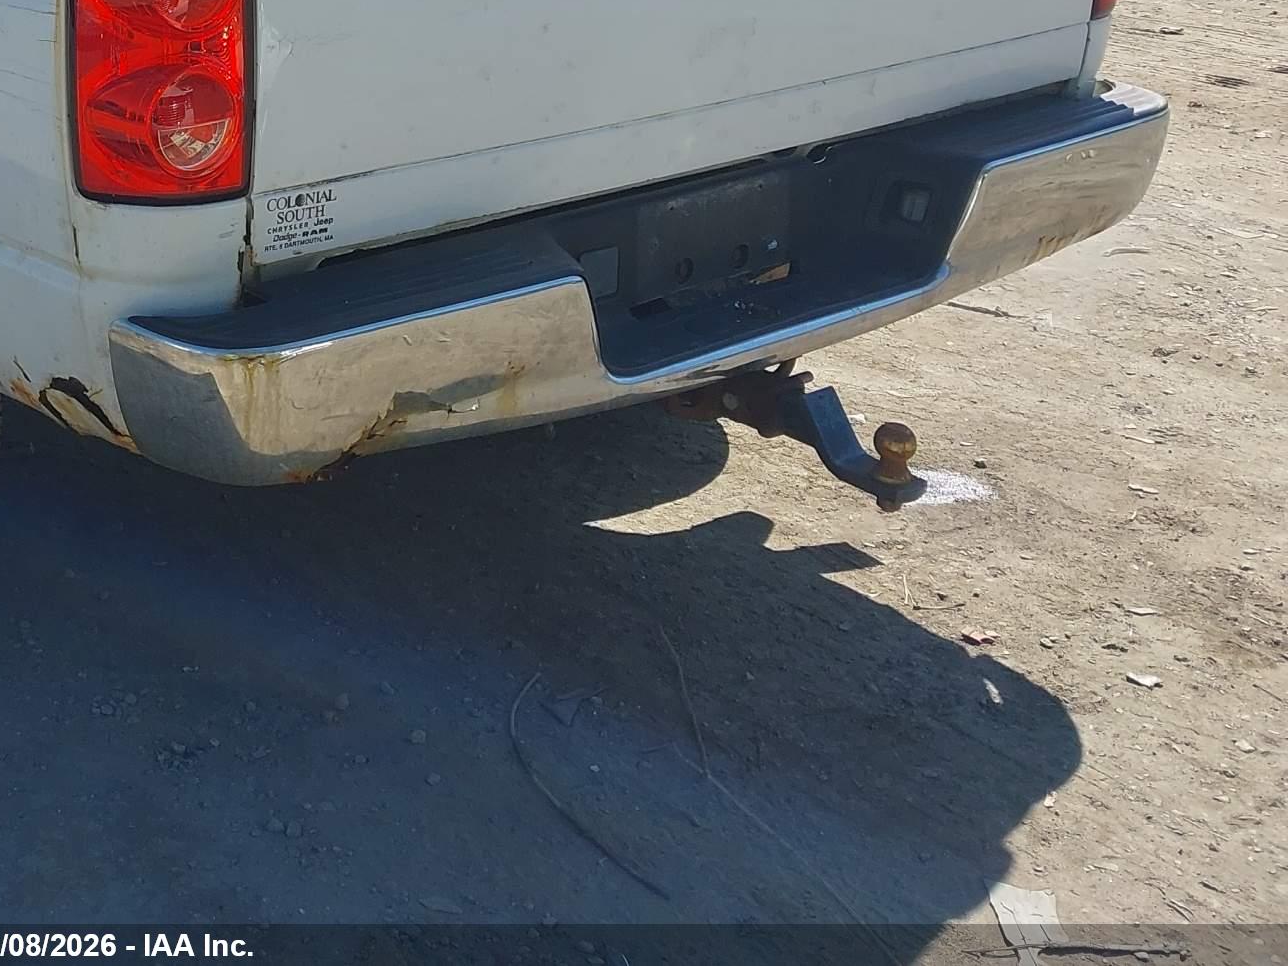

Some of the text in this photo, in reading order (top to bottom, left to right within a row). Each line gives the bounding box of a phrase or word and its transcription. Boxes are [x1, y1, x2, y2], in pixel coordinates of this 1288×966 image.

[267, 189, 337, 212] COLONIAL
[277, 205, 325, 224] SOUTH
[267, 217, 334, 234] CHRYSLER Jeep
